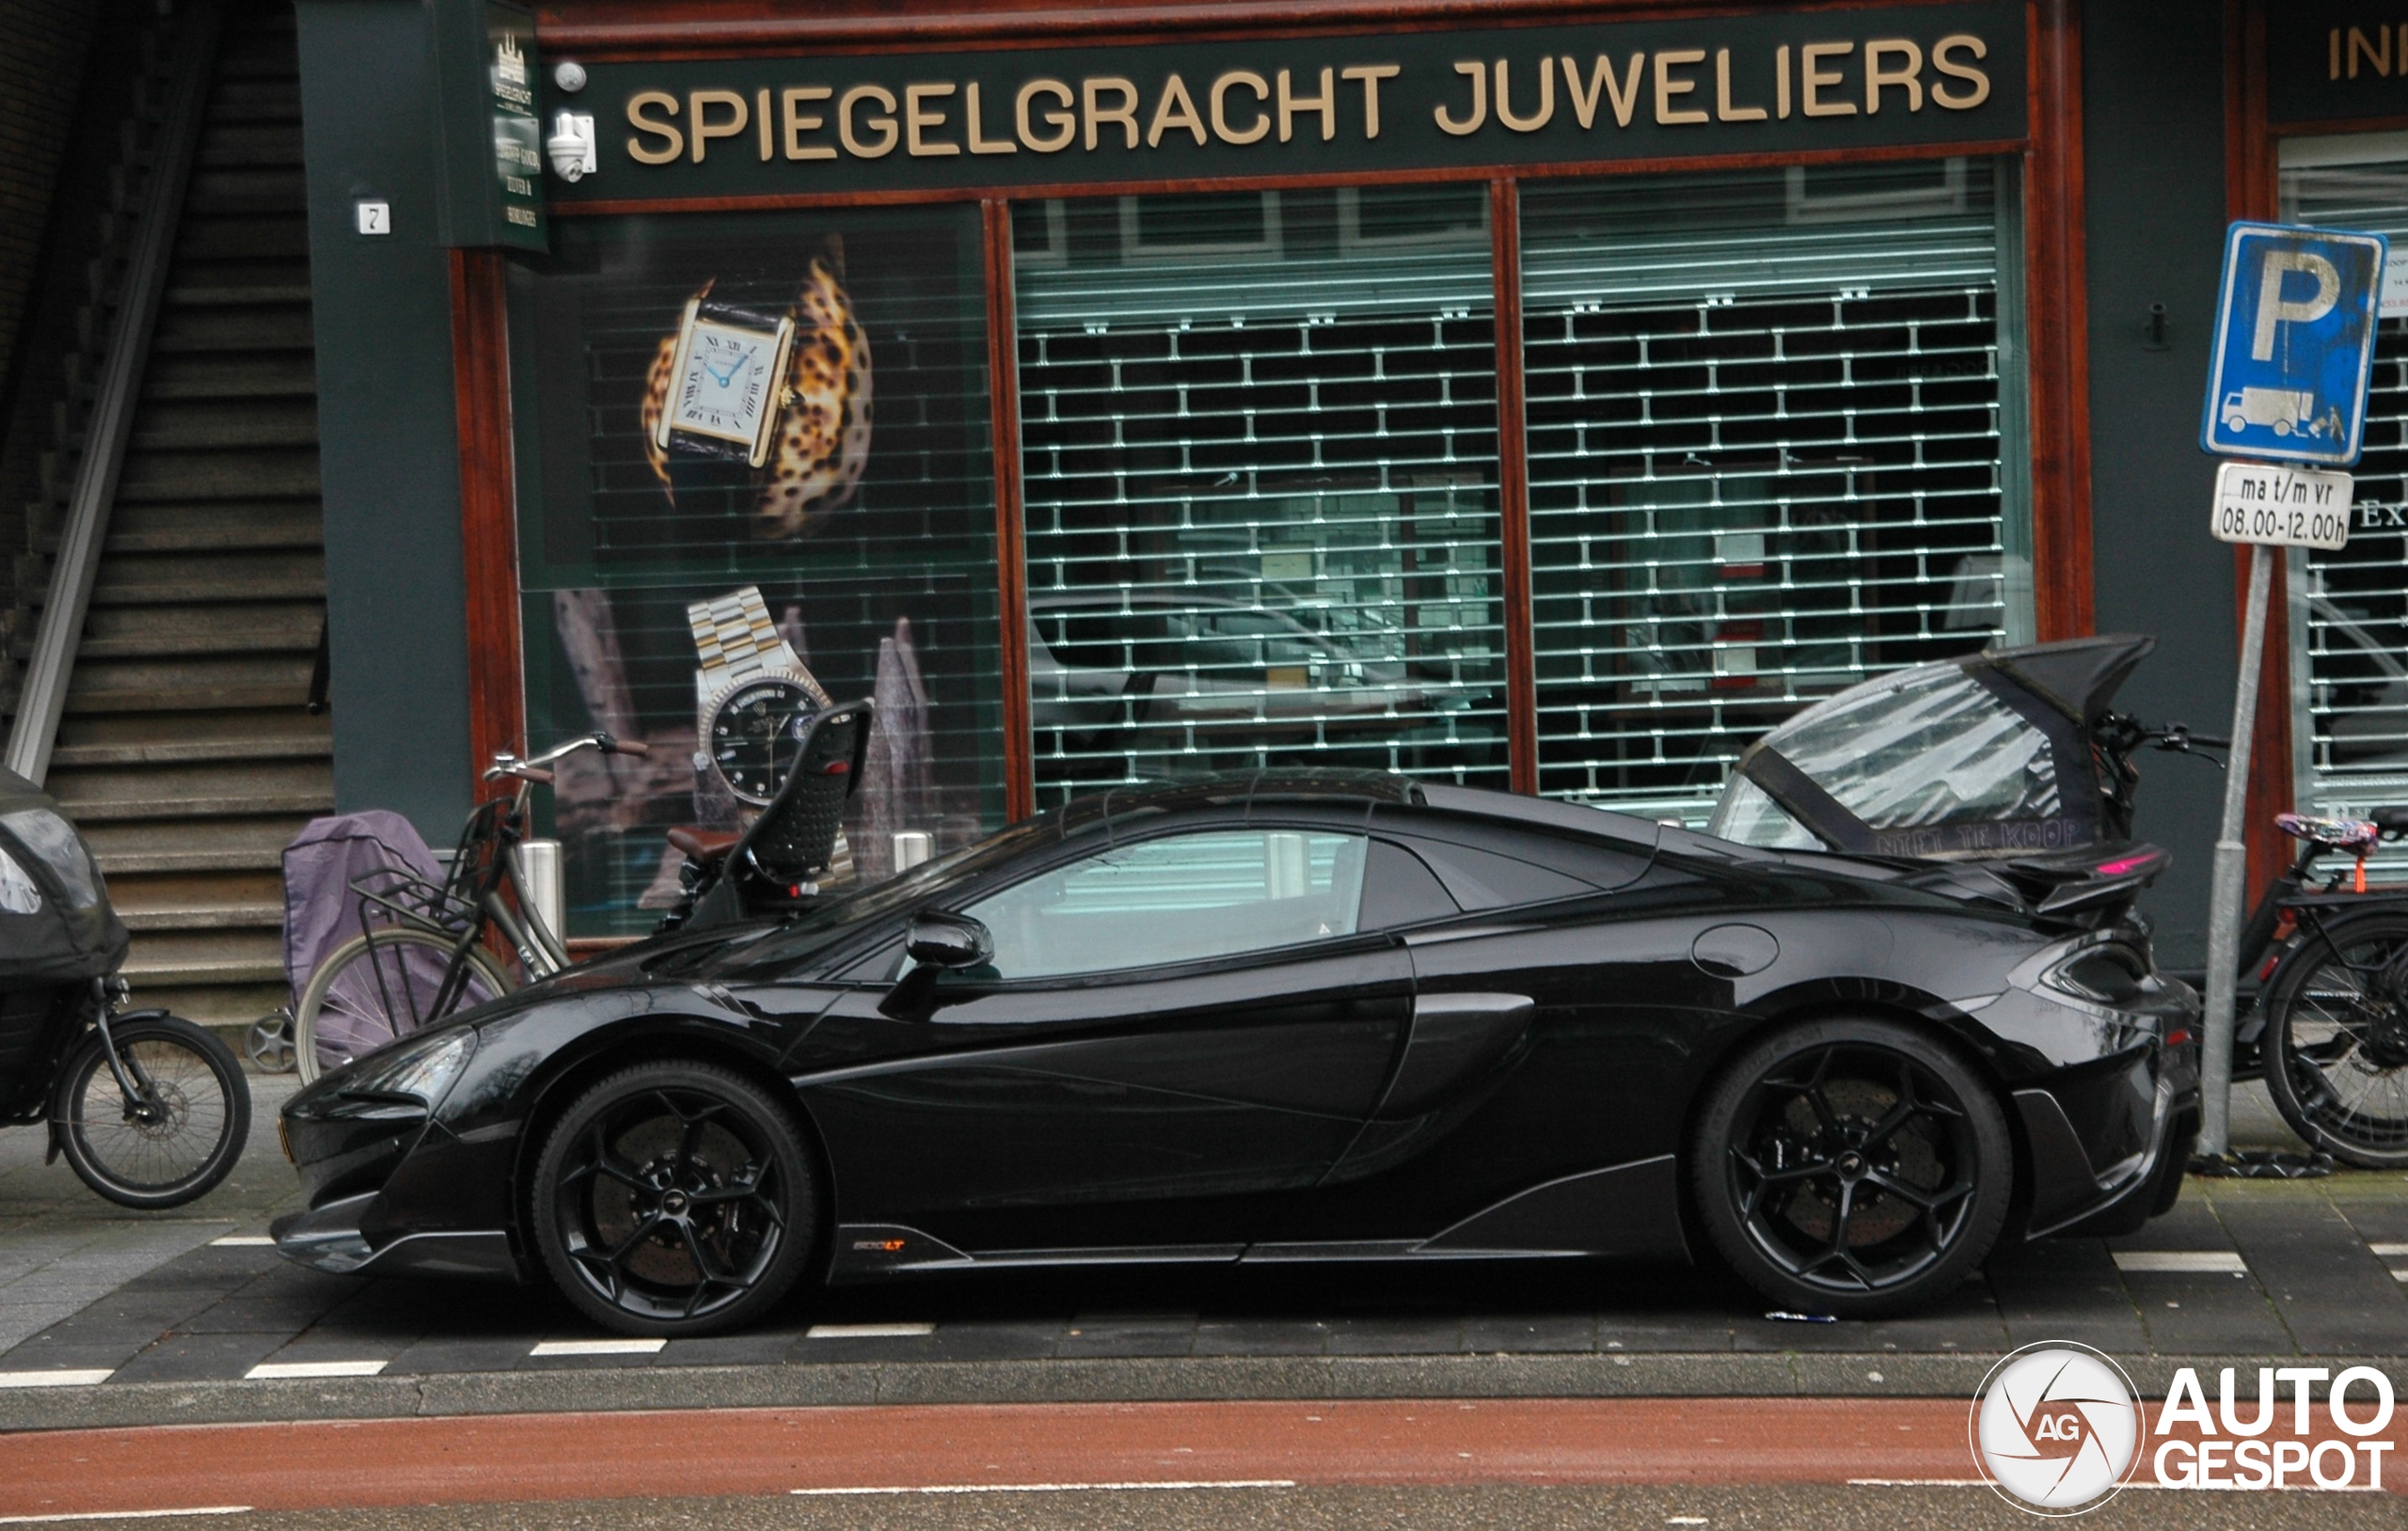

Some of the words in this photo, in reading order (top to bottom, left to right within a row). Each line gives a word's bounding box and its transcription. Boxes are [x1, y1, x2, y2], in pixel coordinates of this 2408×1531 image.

[2329, 23, 2408, 81] IN
[626, 65, 1401, 165] SPIEGELGRACHT
[1434, 34, 1990, 135] JUWELIERS
[369, 208, 380, 229] 7
[2251, 250, 2341, 362] P
[2241, 478, 2267, 501] ma
[2274, 472, 2307, 505] t/m
[2315, 483, 2334, 505] vr
[2222, 506, 2345, 543] 08.00-12.00h
[1877, 828, 1942, 857] NIET
[1956, 824, 1990, 849] TE
[2001, 818, 2081, 849] KOOP
